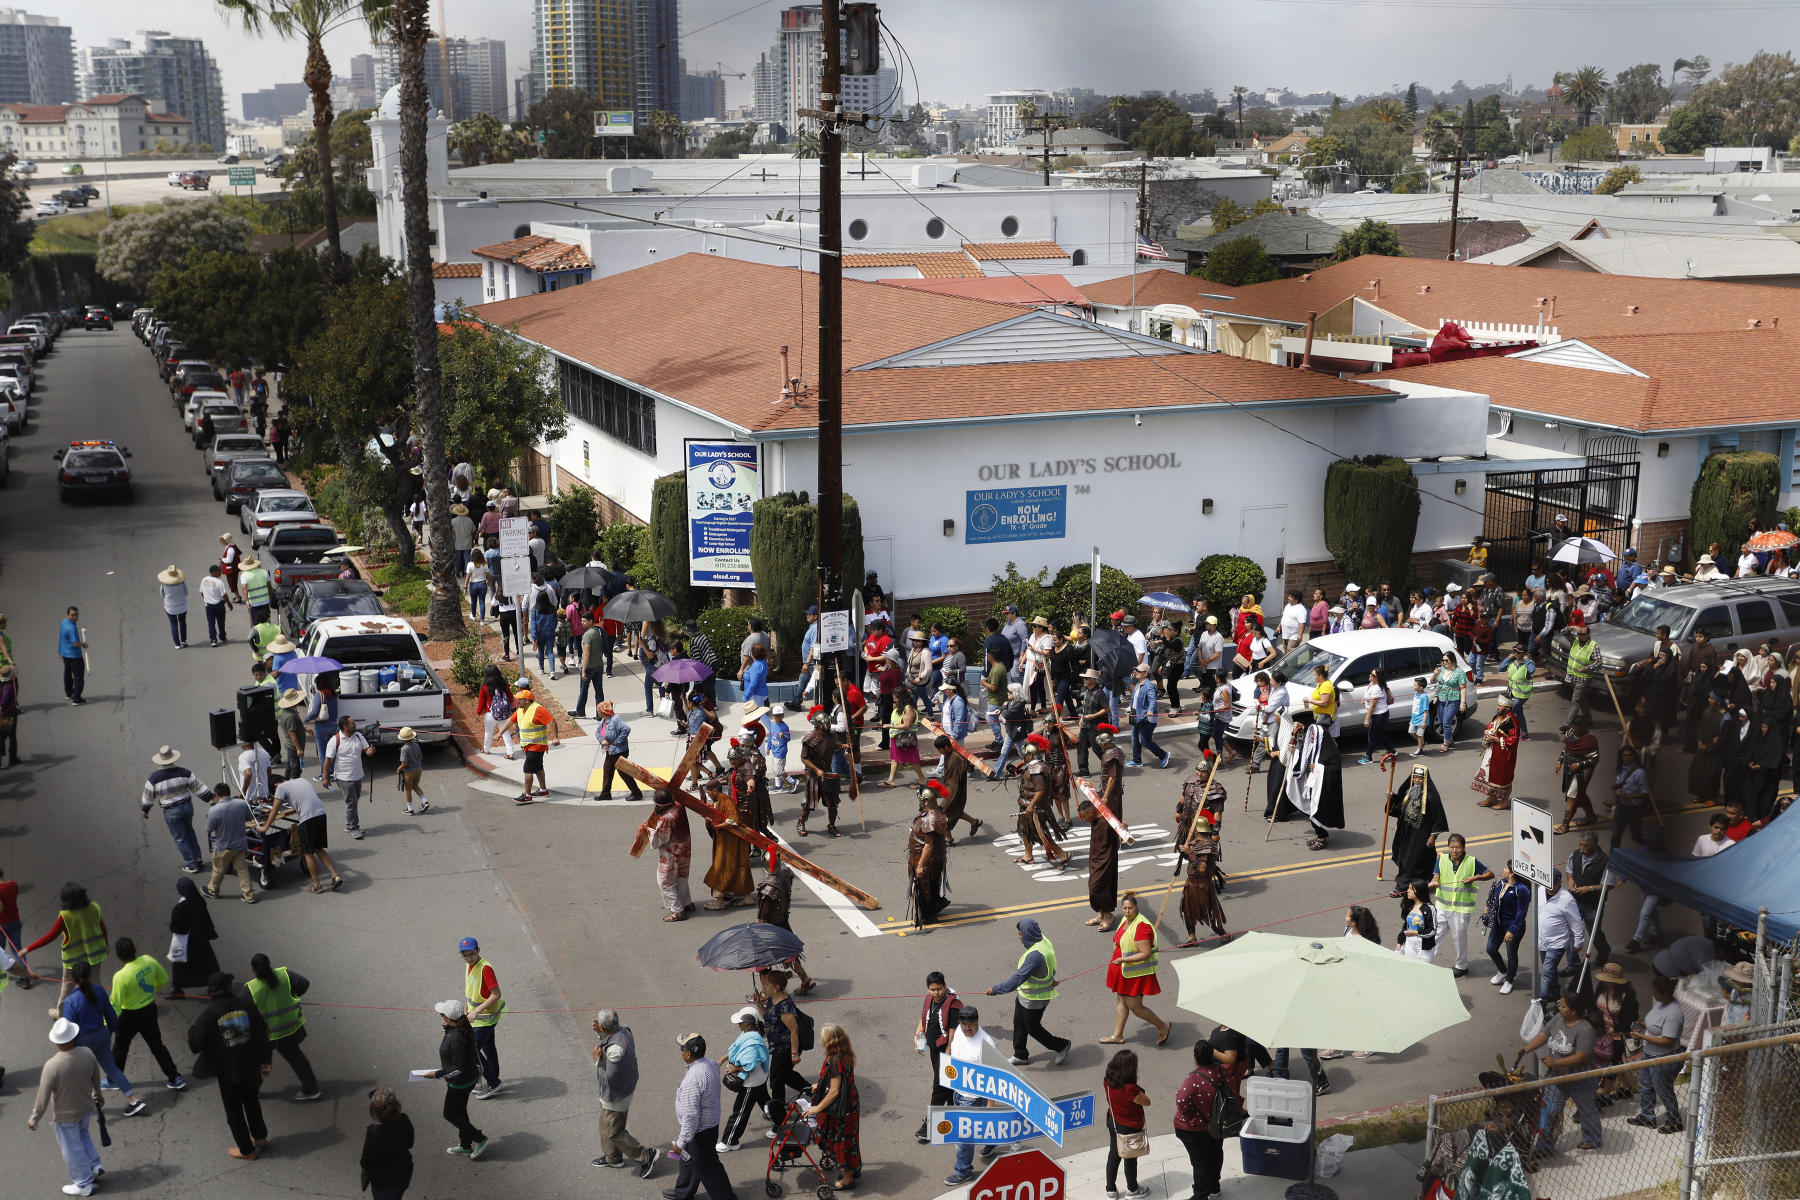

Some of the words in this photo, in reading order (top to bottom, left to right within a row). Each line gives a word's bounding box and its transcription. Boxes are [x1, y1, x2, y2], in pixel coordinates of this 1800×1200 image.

[708, 450, 727, 458] LADY'S
[978, 464, 1020, 481] OUR
[1030, 458, 1097, 478] LADY'S
[1104, 453, 1181, 473] SCHOOL
[974, 493, 993, 502] OUR
[995, 490, 1025, 500] LADY'S
[1028, 488, 1062, 498] SCHOOL
[1017, 504, 1040, 514] NOW
[501, 520, 510, 528] NO
[1001, 512, 1057, 525] ENROLLING!
[502, 529, 526, 537] PARKING
[1515, 859, 1529, 872] OVER
[1530, 864, 1536, 878] 5
[1537, 869, 1550, 883] TONS
[962, 1066, 1031, 1114] KEARNEY
[1072, 1101, 1082, 1111] ST
[1047, 1106, 1056, 1120] AV
[1070, 1111, 1086, 1122] 700
[1044, 1117, 1059, 1134] 1800
